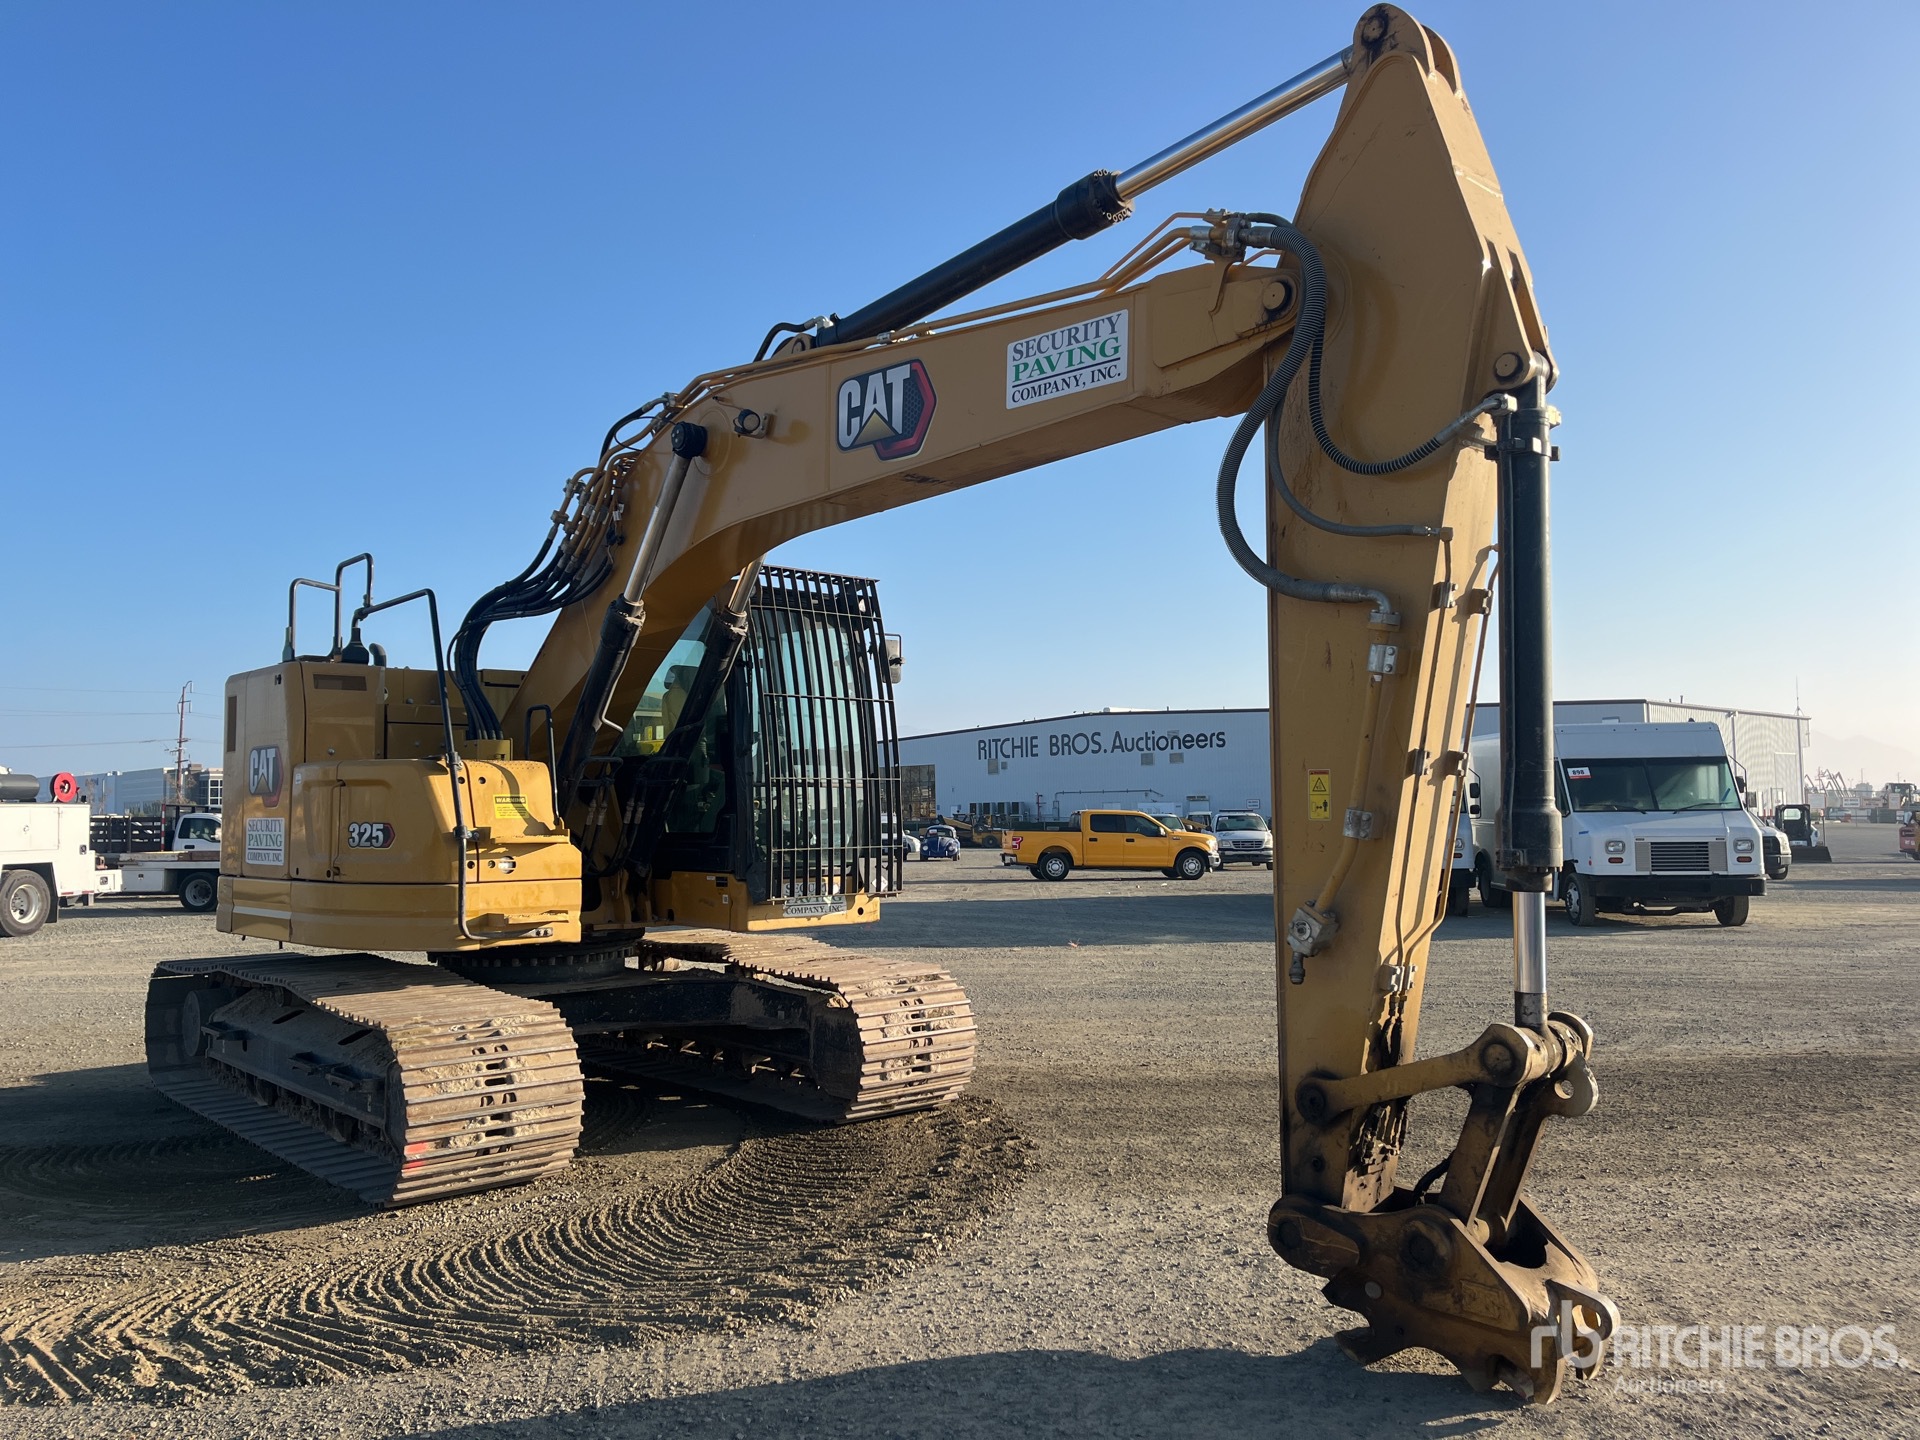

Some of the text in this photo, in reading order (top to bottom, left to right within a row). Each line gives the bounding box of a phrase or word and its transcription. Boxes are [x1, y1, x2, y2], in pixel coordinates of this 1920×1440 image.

[1011, 313, 1122, 362] SECURITY
[1012, 336, 1121, 383] PAVING
[1011, 365, 1121, 403] COMPANY, INC.
[838, 364, 910, 449] CAT
[978, 731, 1226, 760] RITCHIE BROS. Auctioneers
[250, 748, 276, 794] CAT
[248, 819, 282, 833] SECURITY
[248, 834, 282, 848] PAVING
[349, 823, 384, 847] 325
[247, 852, 283, 863] COMPANY, INC.
